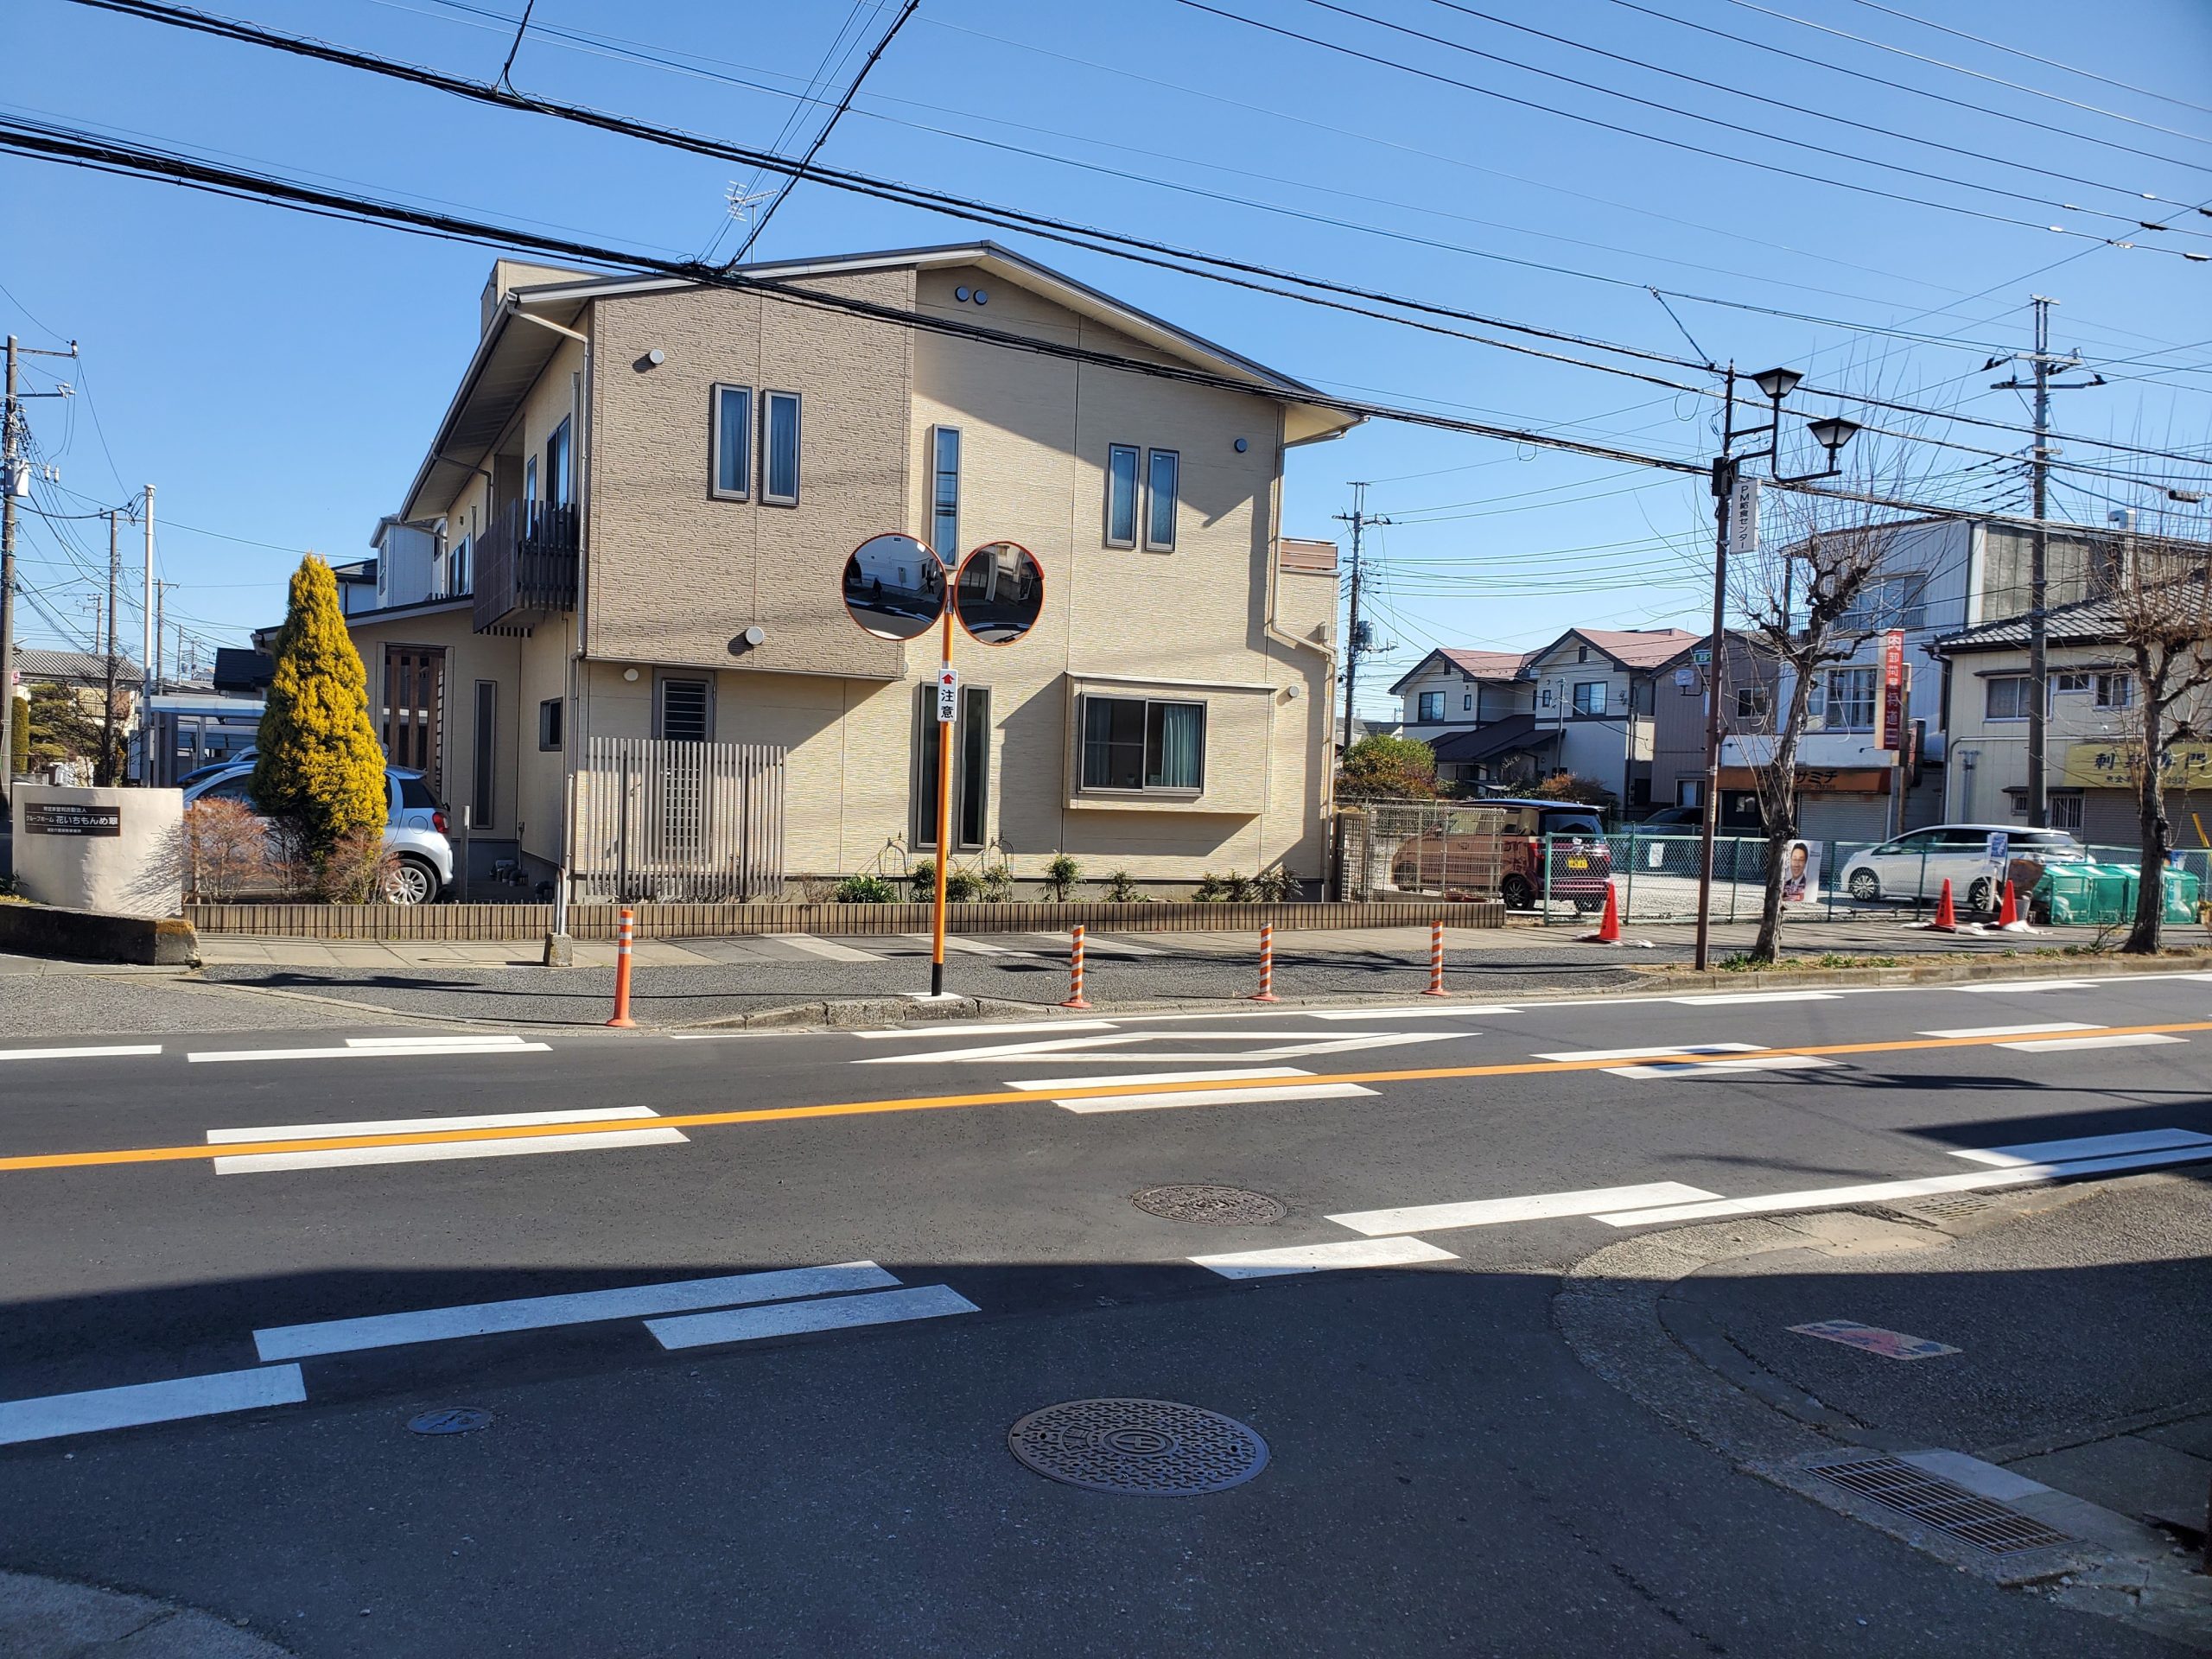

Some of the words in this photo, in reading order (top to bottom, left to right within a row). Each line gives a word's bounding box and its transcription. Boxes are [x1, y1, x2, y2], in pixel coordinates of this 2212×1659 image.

[1738, 485, 1750, 550] PM給食センター
[940, 689, 955, 719] 注意
